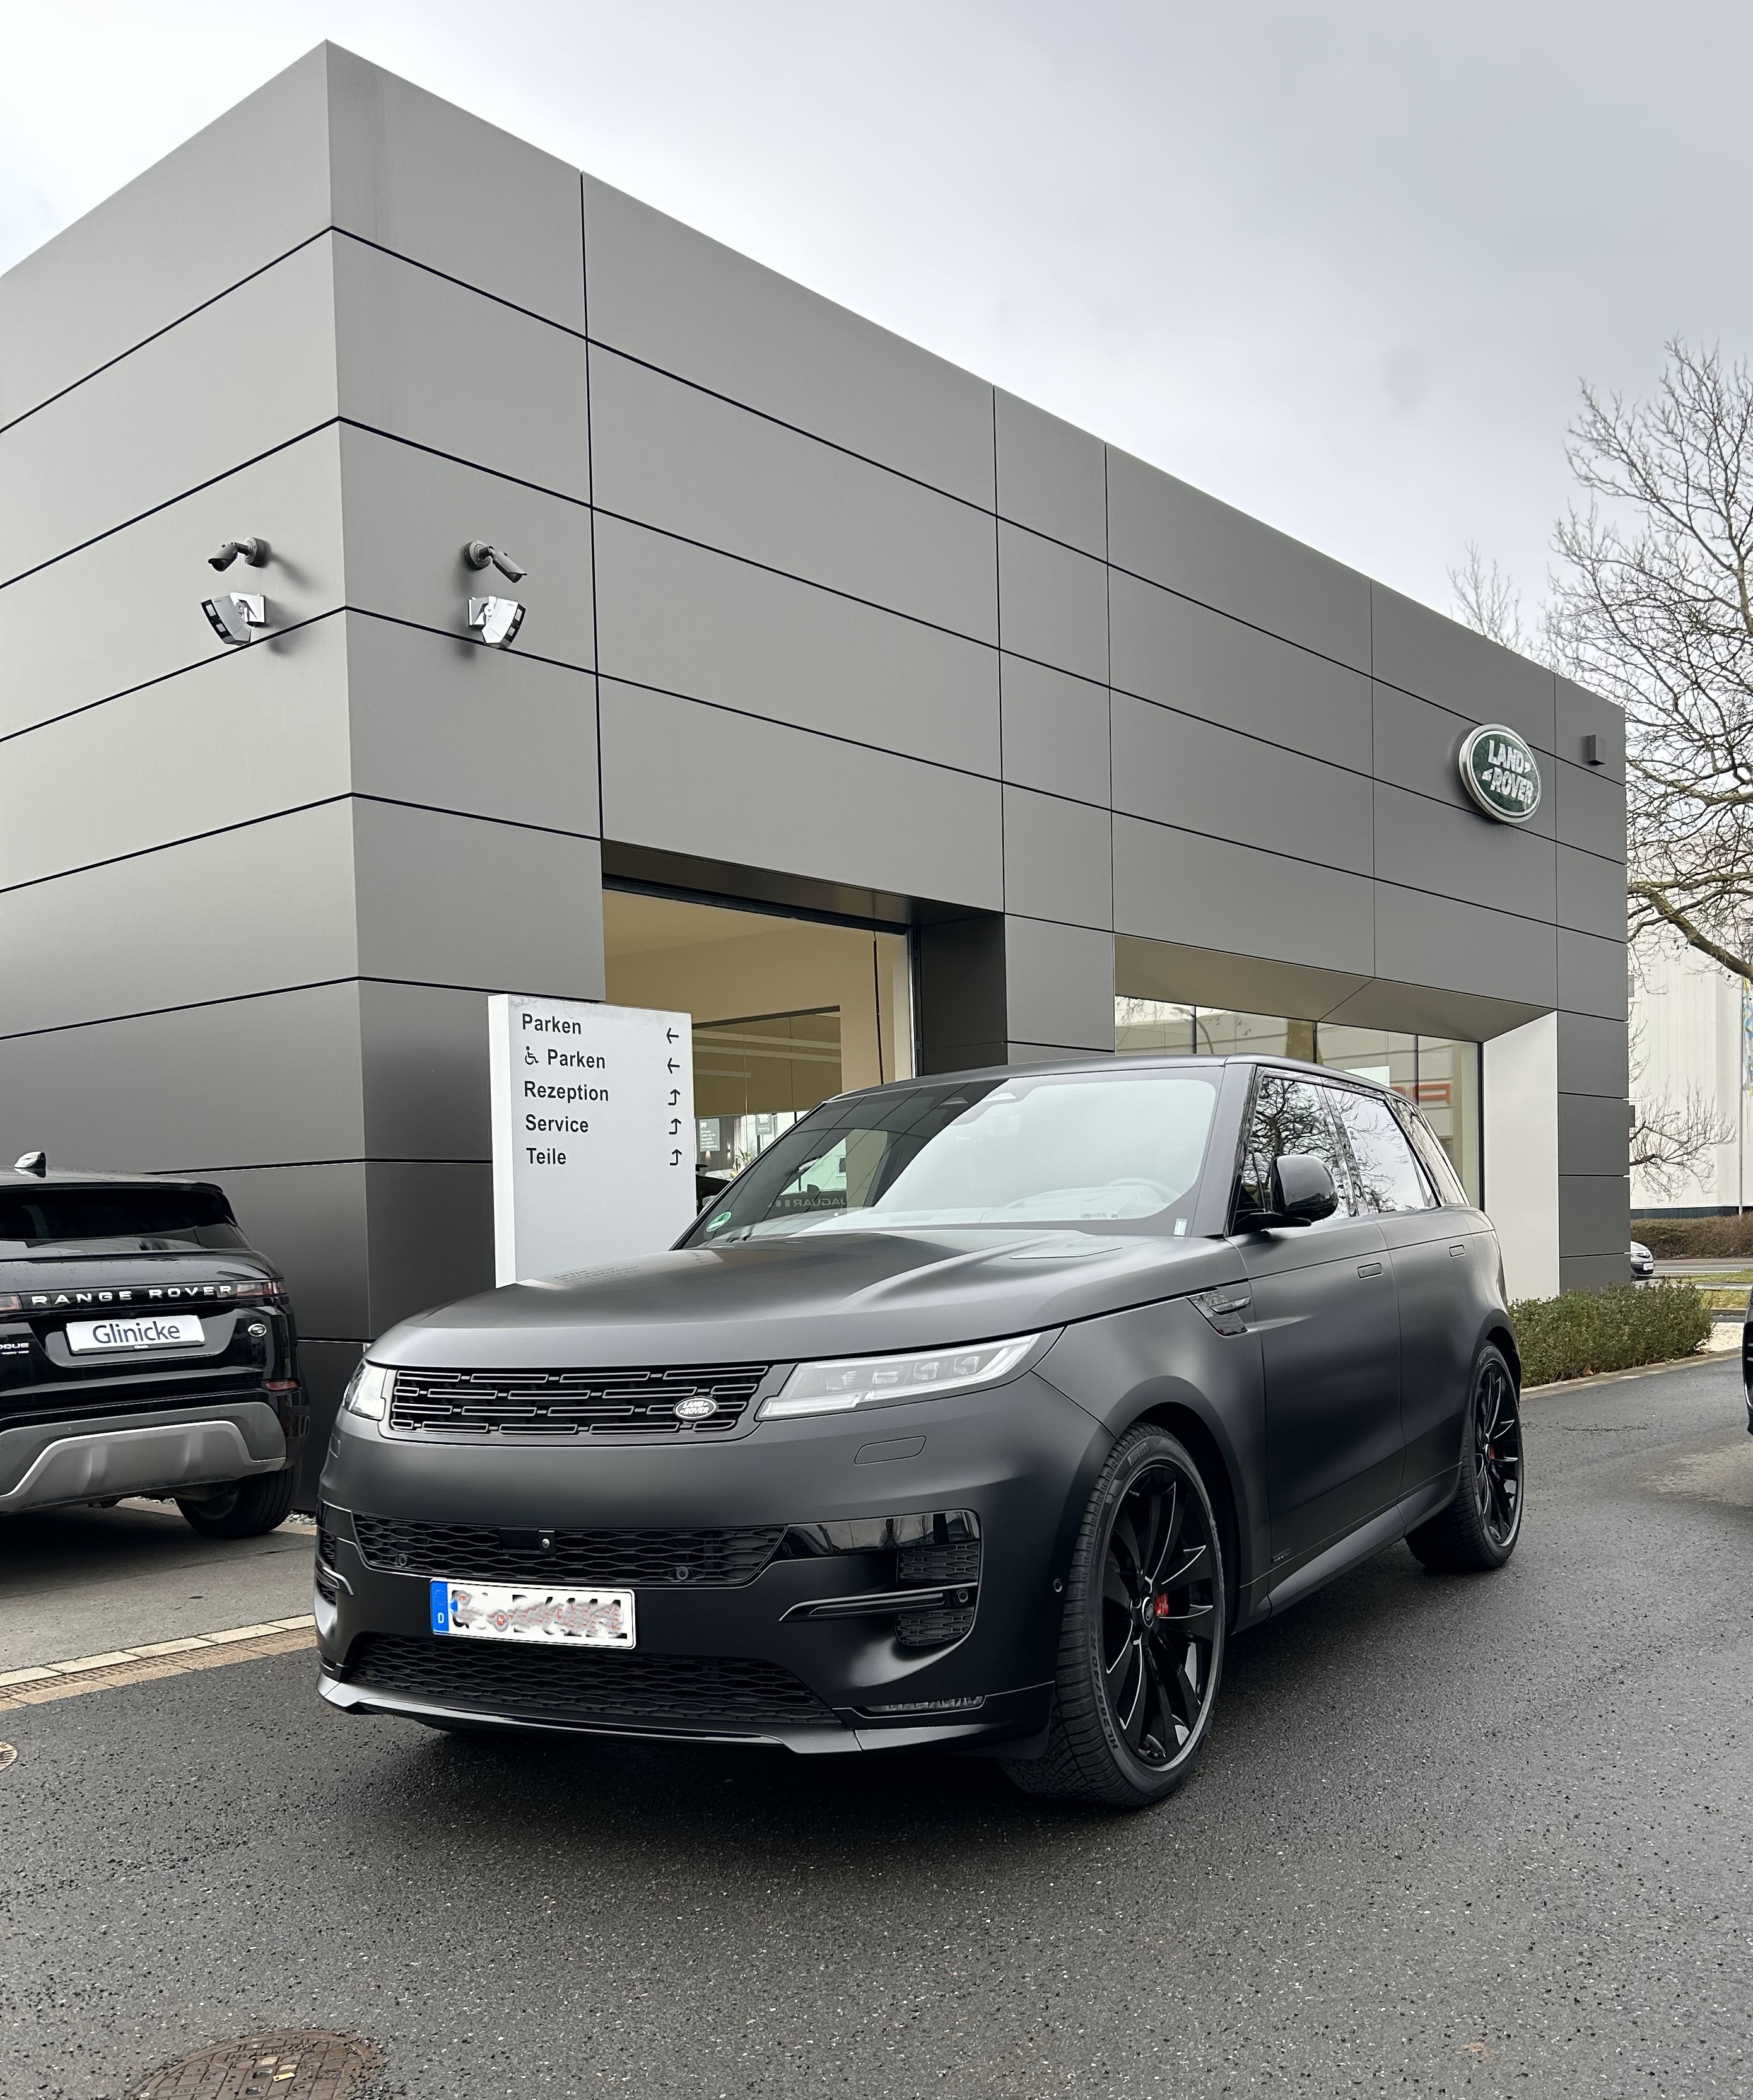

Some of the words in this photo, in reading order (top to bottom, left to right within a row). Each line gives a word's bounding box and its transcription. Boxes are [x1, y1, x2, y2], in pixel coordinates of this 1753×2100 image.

[1488, 740, 1524, 774] LAND
[1490, 767, 1533, 805] ROVER
[522, 1013, 582, 1035] Parken
[548, 1049, 606, 1069] Parken
[524, 1081, 609, 1103] Rezeption
[525, 1114, 589, 1133] Service
[526, 1148, 566, 1165] Teile
[32, 1290, 132, 1305] RANGE
[149, 1285, 232, 1299] ROVER
[92, 1321, 181, 1344] Glinicke
[1127, 1442, 1149, 1467] PIRELLI
[437, 1612, 445, 1624] D
